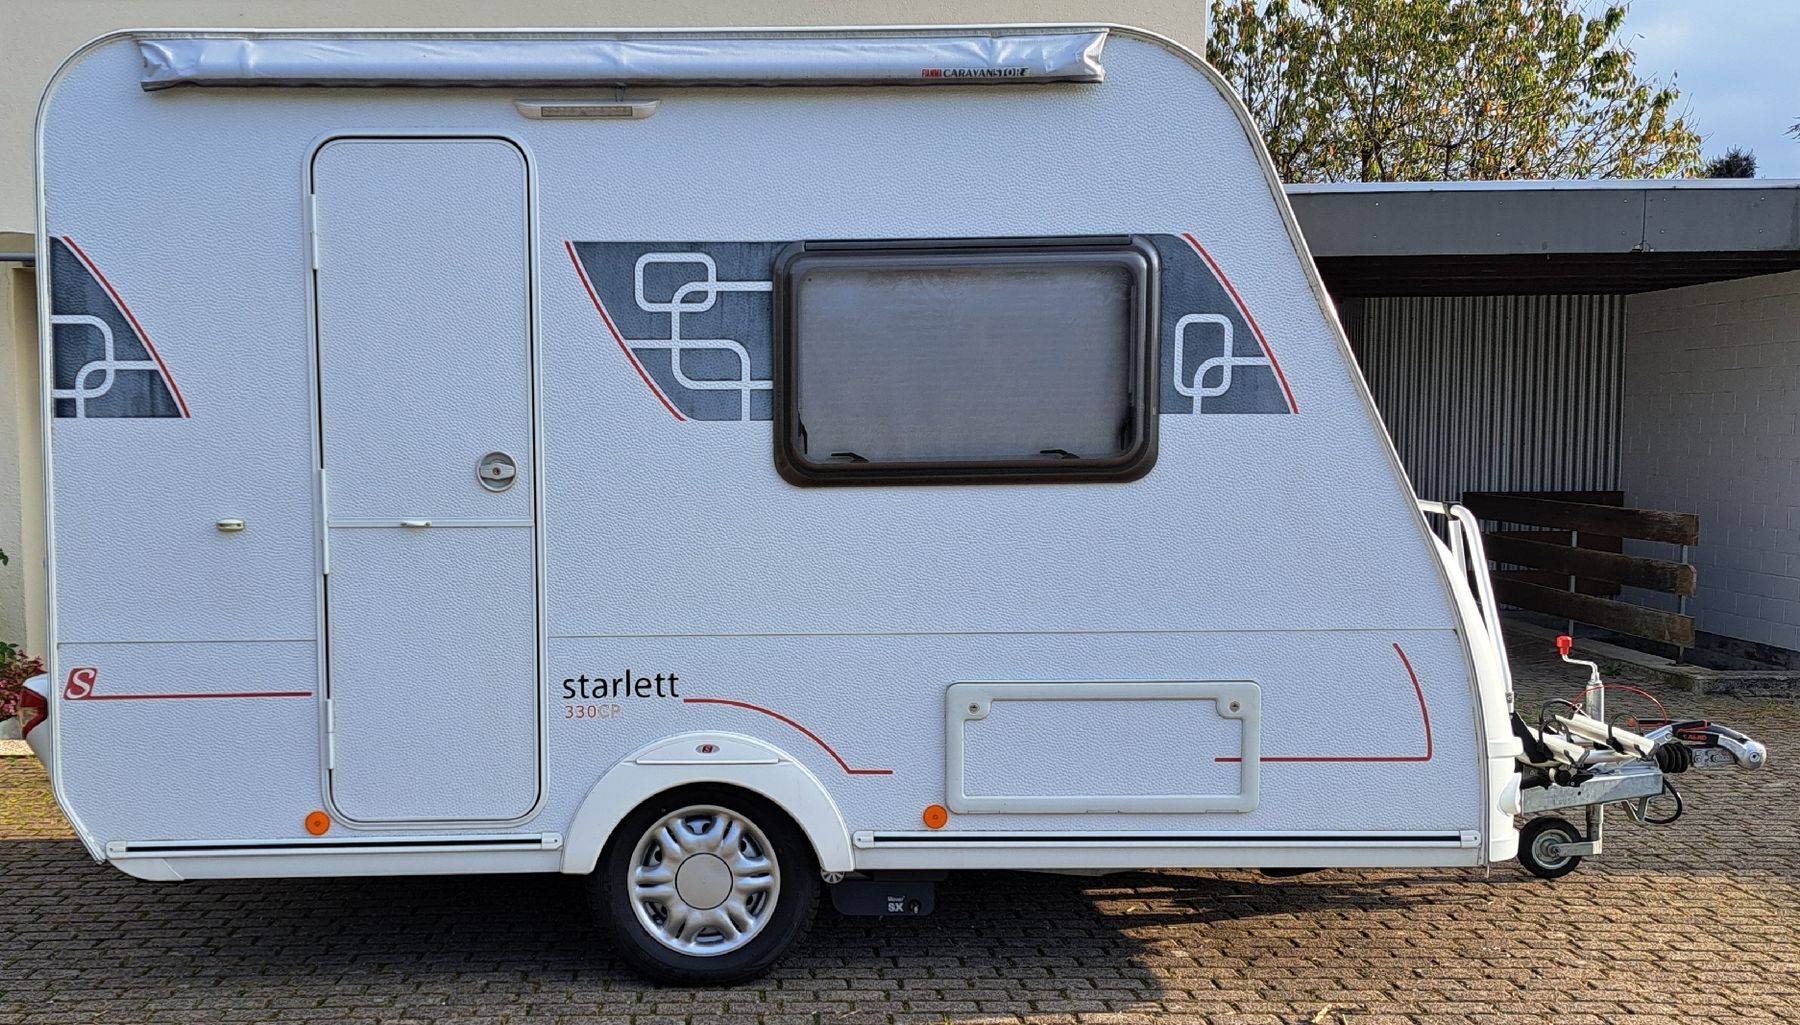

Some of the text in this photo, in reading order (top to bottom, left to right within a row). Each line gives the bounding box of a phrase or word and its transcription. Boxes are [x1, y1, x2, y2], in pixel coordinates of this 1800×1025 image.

[66, 669, 95, 699] S
[562, 669, 679, 699] starlett
[565, 704, 620, 719] 330CP
[888, 902, 904, 912] SX
